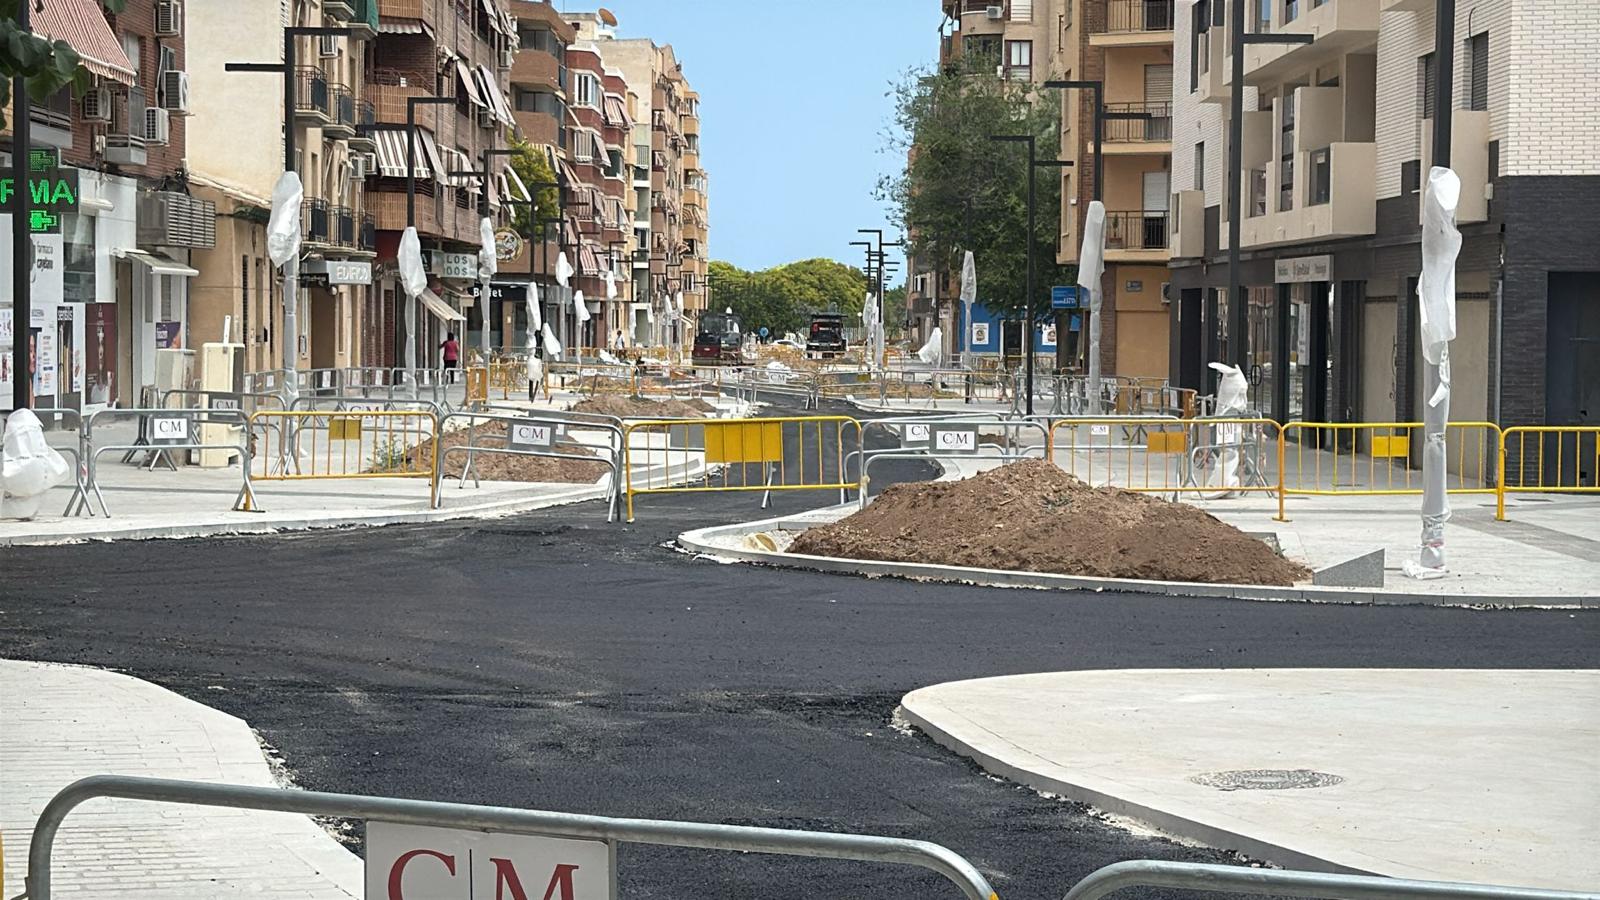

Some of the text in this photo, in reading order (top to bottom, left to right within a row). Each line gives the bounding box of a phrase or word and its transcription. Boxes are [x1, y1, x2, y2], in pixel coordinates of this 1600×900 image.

[446, 255, 468, 265] LOS
[446, 266, 468, 276] DOS
[159, 420, 182, 433] CM
[519, 427, 544, 440] CM
[942, 432, 968, 445] CM
[388, 849, 579, 900] CM
